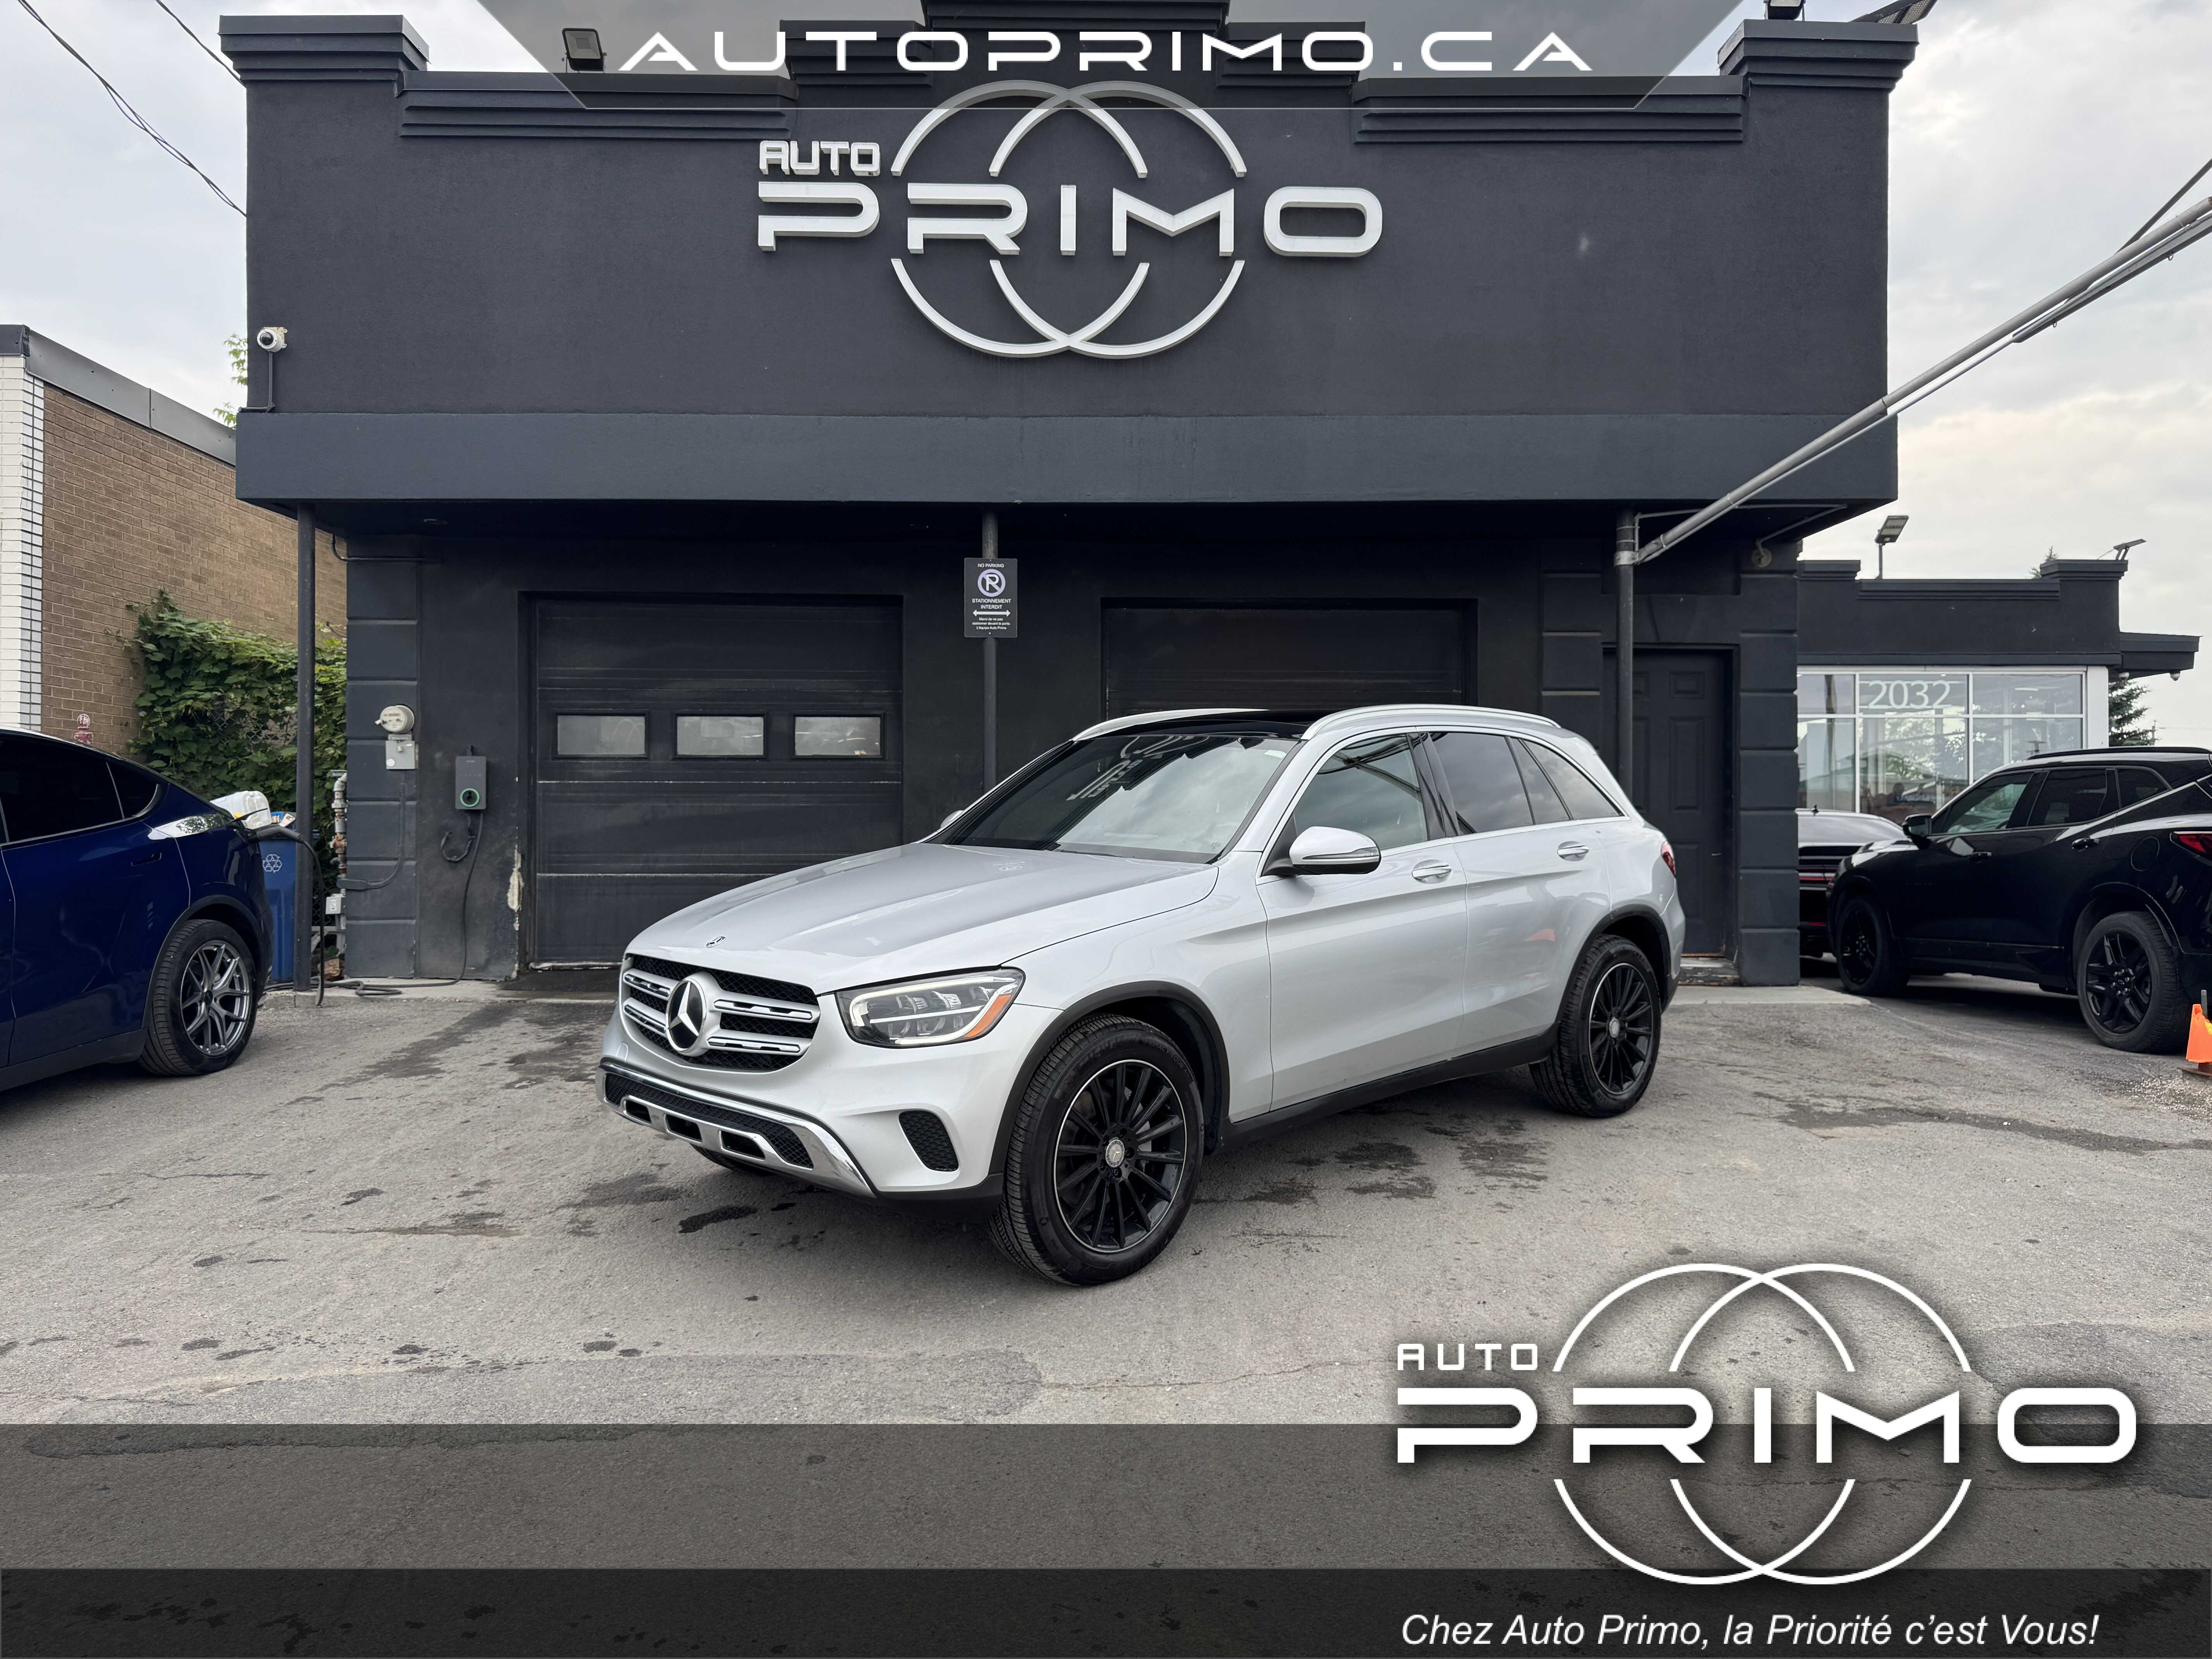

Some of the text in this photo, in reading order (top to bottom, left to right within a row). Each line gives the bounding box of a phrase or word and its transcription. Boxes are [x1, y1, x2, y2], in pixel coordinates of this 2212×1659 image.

[759, 141, 880, 176] AUTO
[758, 181, 1382, 256] PRIMO
[1869, 680, 1952, 709] 2032
[1171, 1054, 1184, 1069] TOUR
